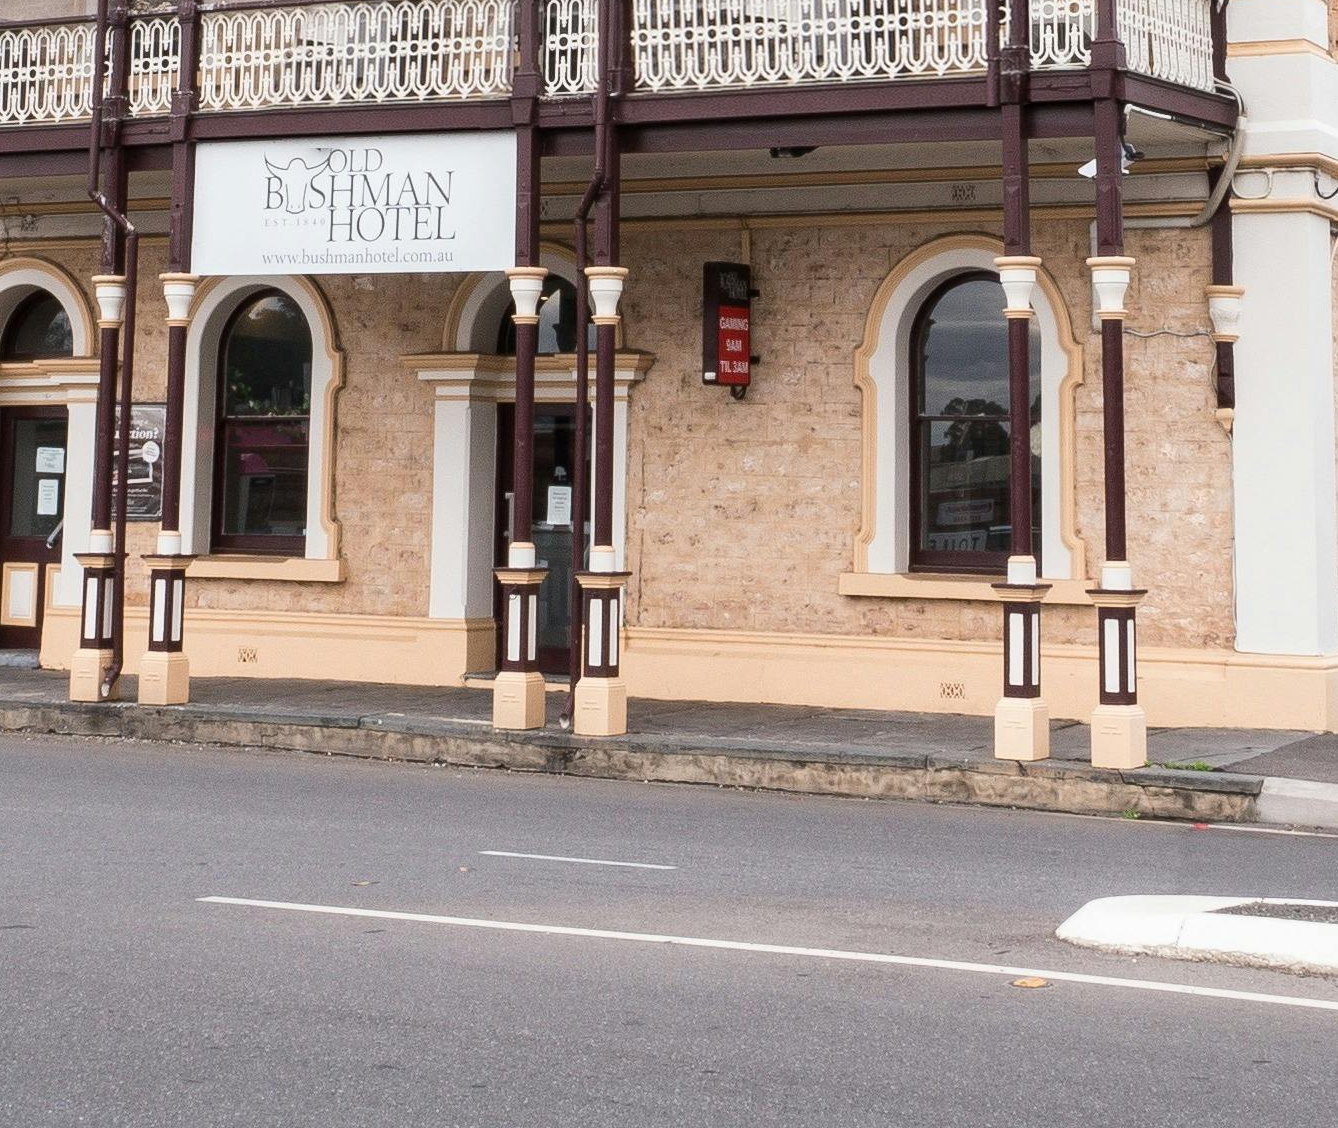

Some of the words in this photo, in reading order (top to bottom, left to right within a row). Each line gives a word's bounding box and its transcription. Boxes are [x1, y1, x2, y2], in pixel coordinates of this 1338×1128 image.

[328, 148, 383, 173] OLD
[264, 170, 455, 214] BUSHMAN
[326, 206, 456, 242] HOTEL
[262, 246, 454, 264] www.bushmanhotel.com.au
[719, 317, 749, 331] GAMING
